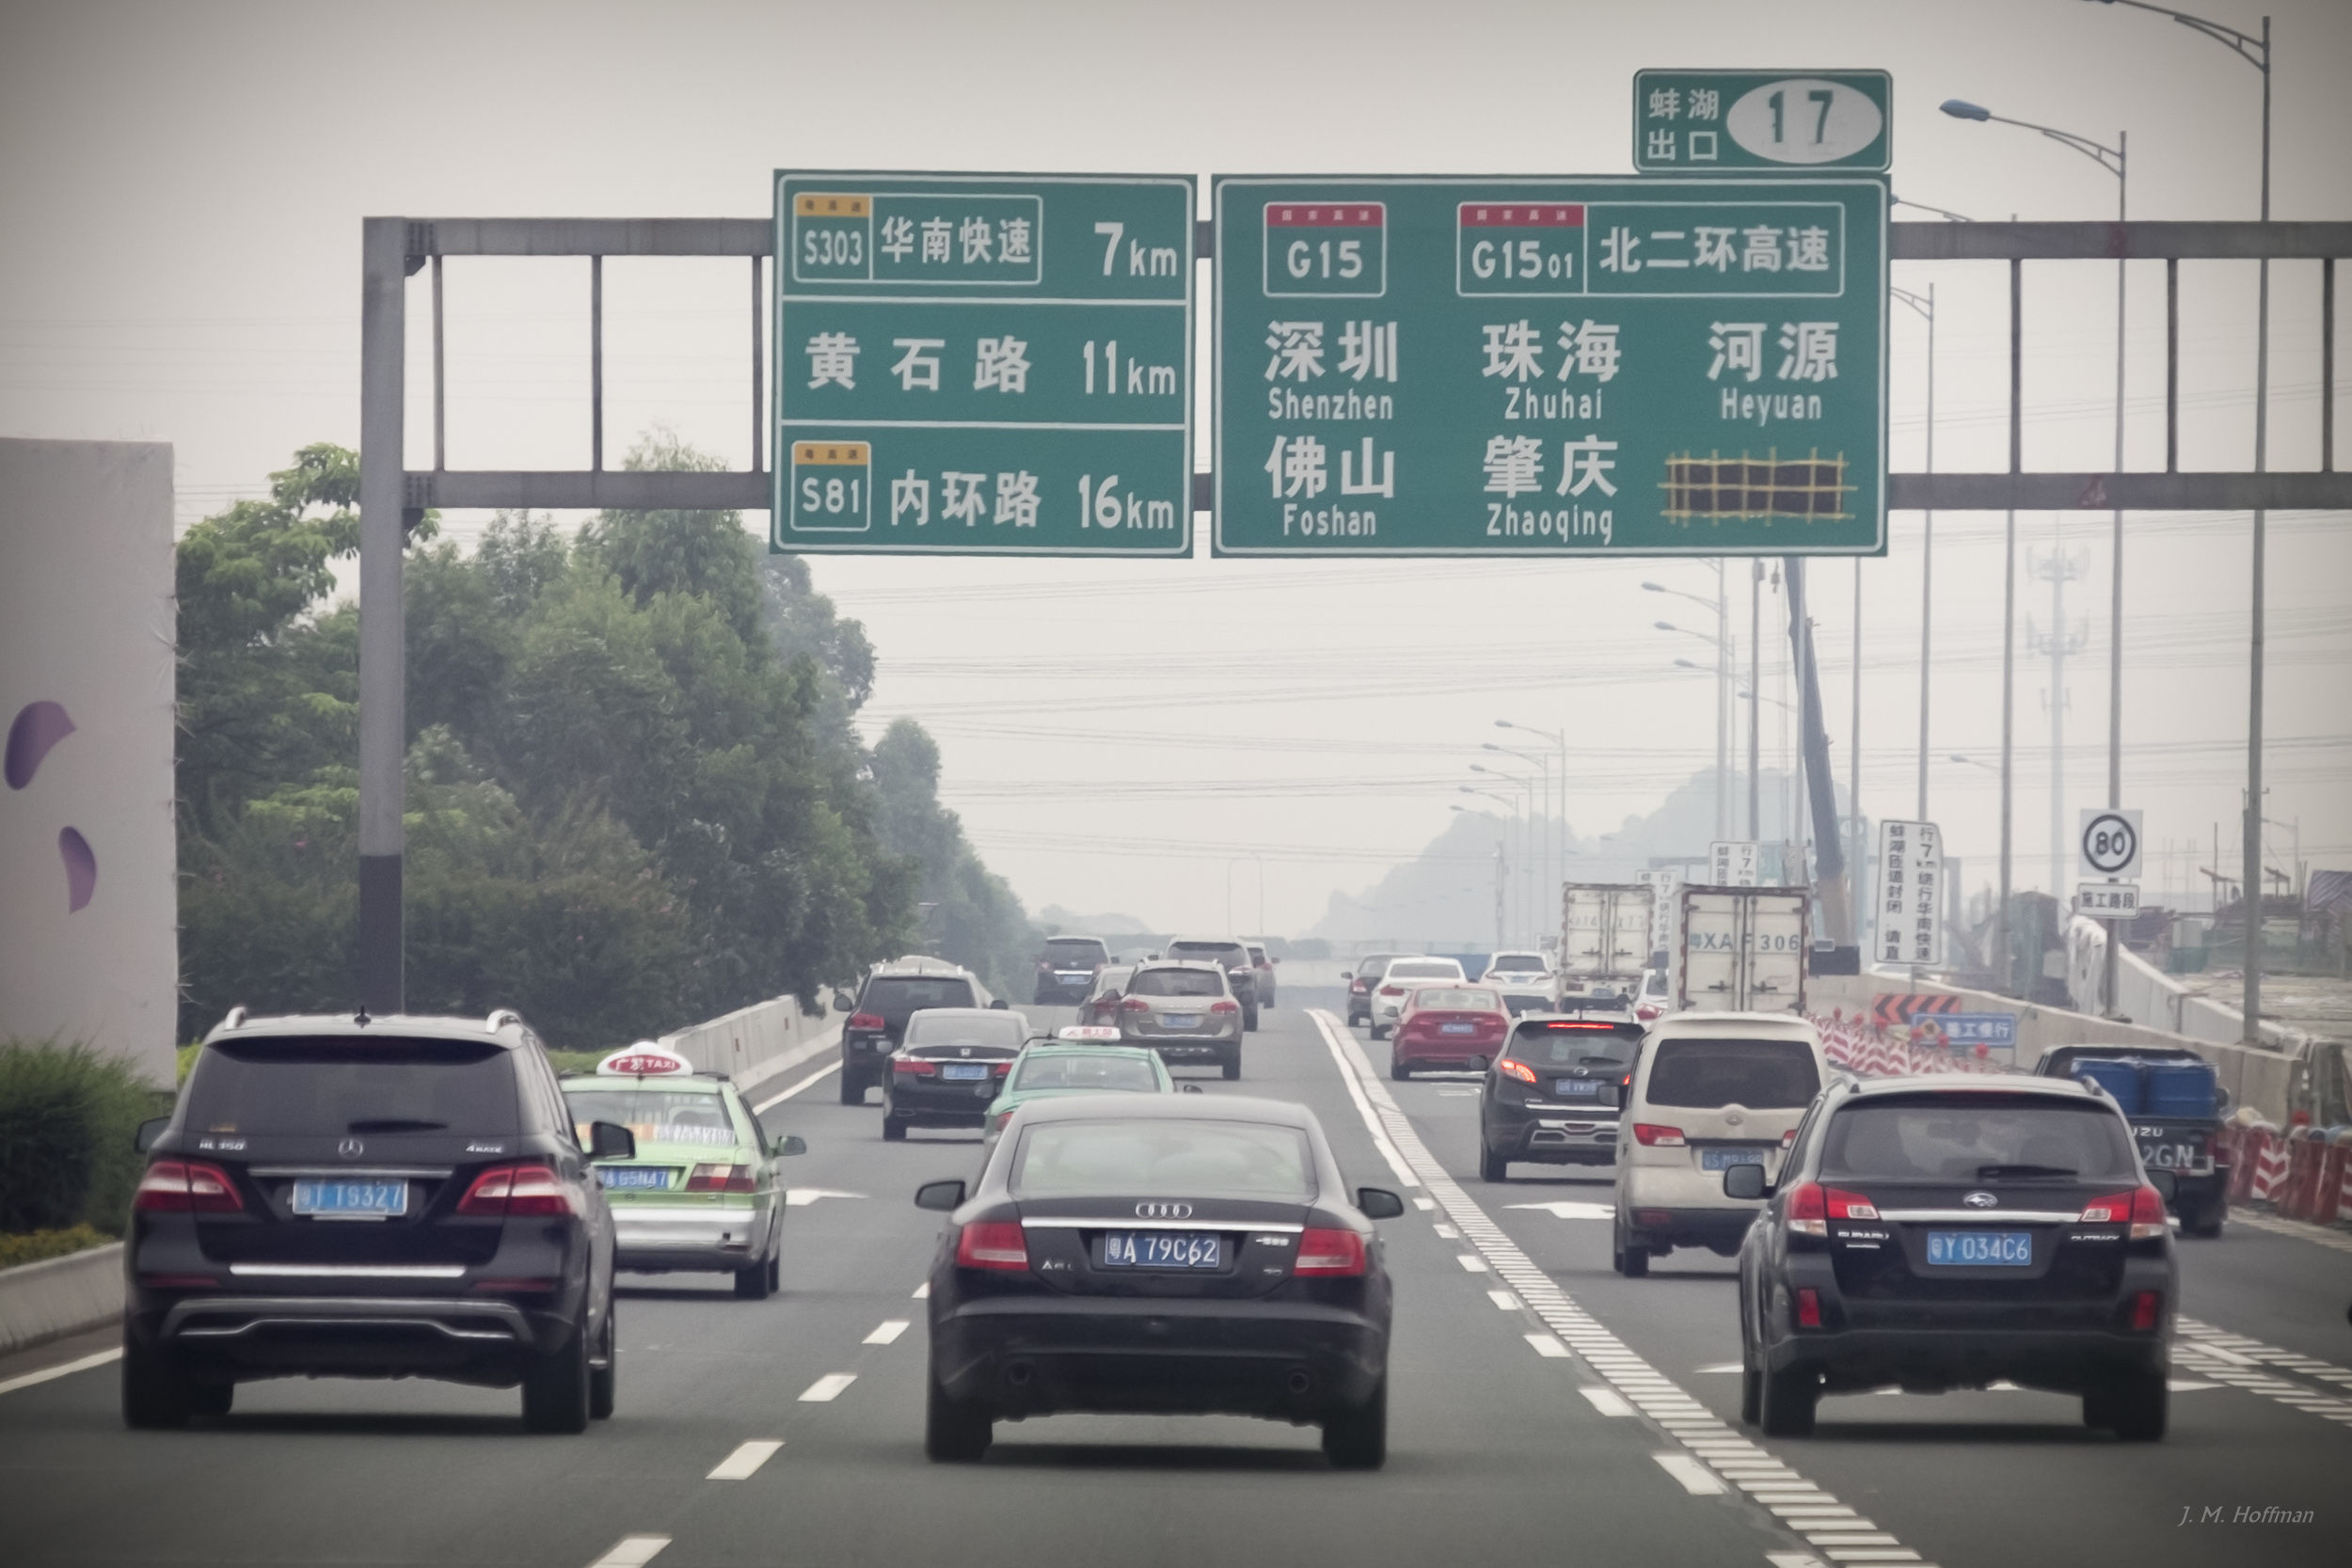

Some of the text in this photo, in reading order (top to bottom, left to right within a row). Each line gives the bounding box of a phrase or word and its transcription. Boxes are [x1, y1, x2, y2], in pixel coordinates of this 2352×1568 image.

[1768, 88, 1834, 144] 17
[1646, 128, 1718, 161] 出口
[804, 230, 863, 266] S303
[881, 215, 1031, 264] 华南快速
[1287, 240, 1363, 278] G15
[1599, 224, 1830, 273] 北二环高速
[804, 331, 1031, 393] 黄石路
[1263, 320, 1398, 383] 深圳
[1482, 318, 1622, 383] 珠海
[1707, 321, 1839, 383] 河源
[1268, 387, 1393, 420] Shenzhen
[1504, 387, 1602, 420] Zhuhai
[1721, 387, 1821, 427] Heyuan
[1263, 435, 1395, 499] 佛山
[1483, 434, 1618, 499] 肇庆
[802, 477, 859, 514] S81
[891, 468, 1041, 528] 内环路
[1283, 503, 1376, 536] Foshan
[1486, 502, 1613, 545] Zhaoqing
[2094, 832, 2126, 855] 80
[647, 1060, 675, 1069] TAXI
